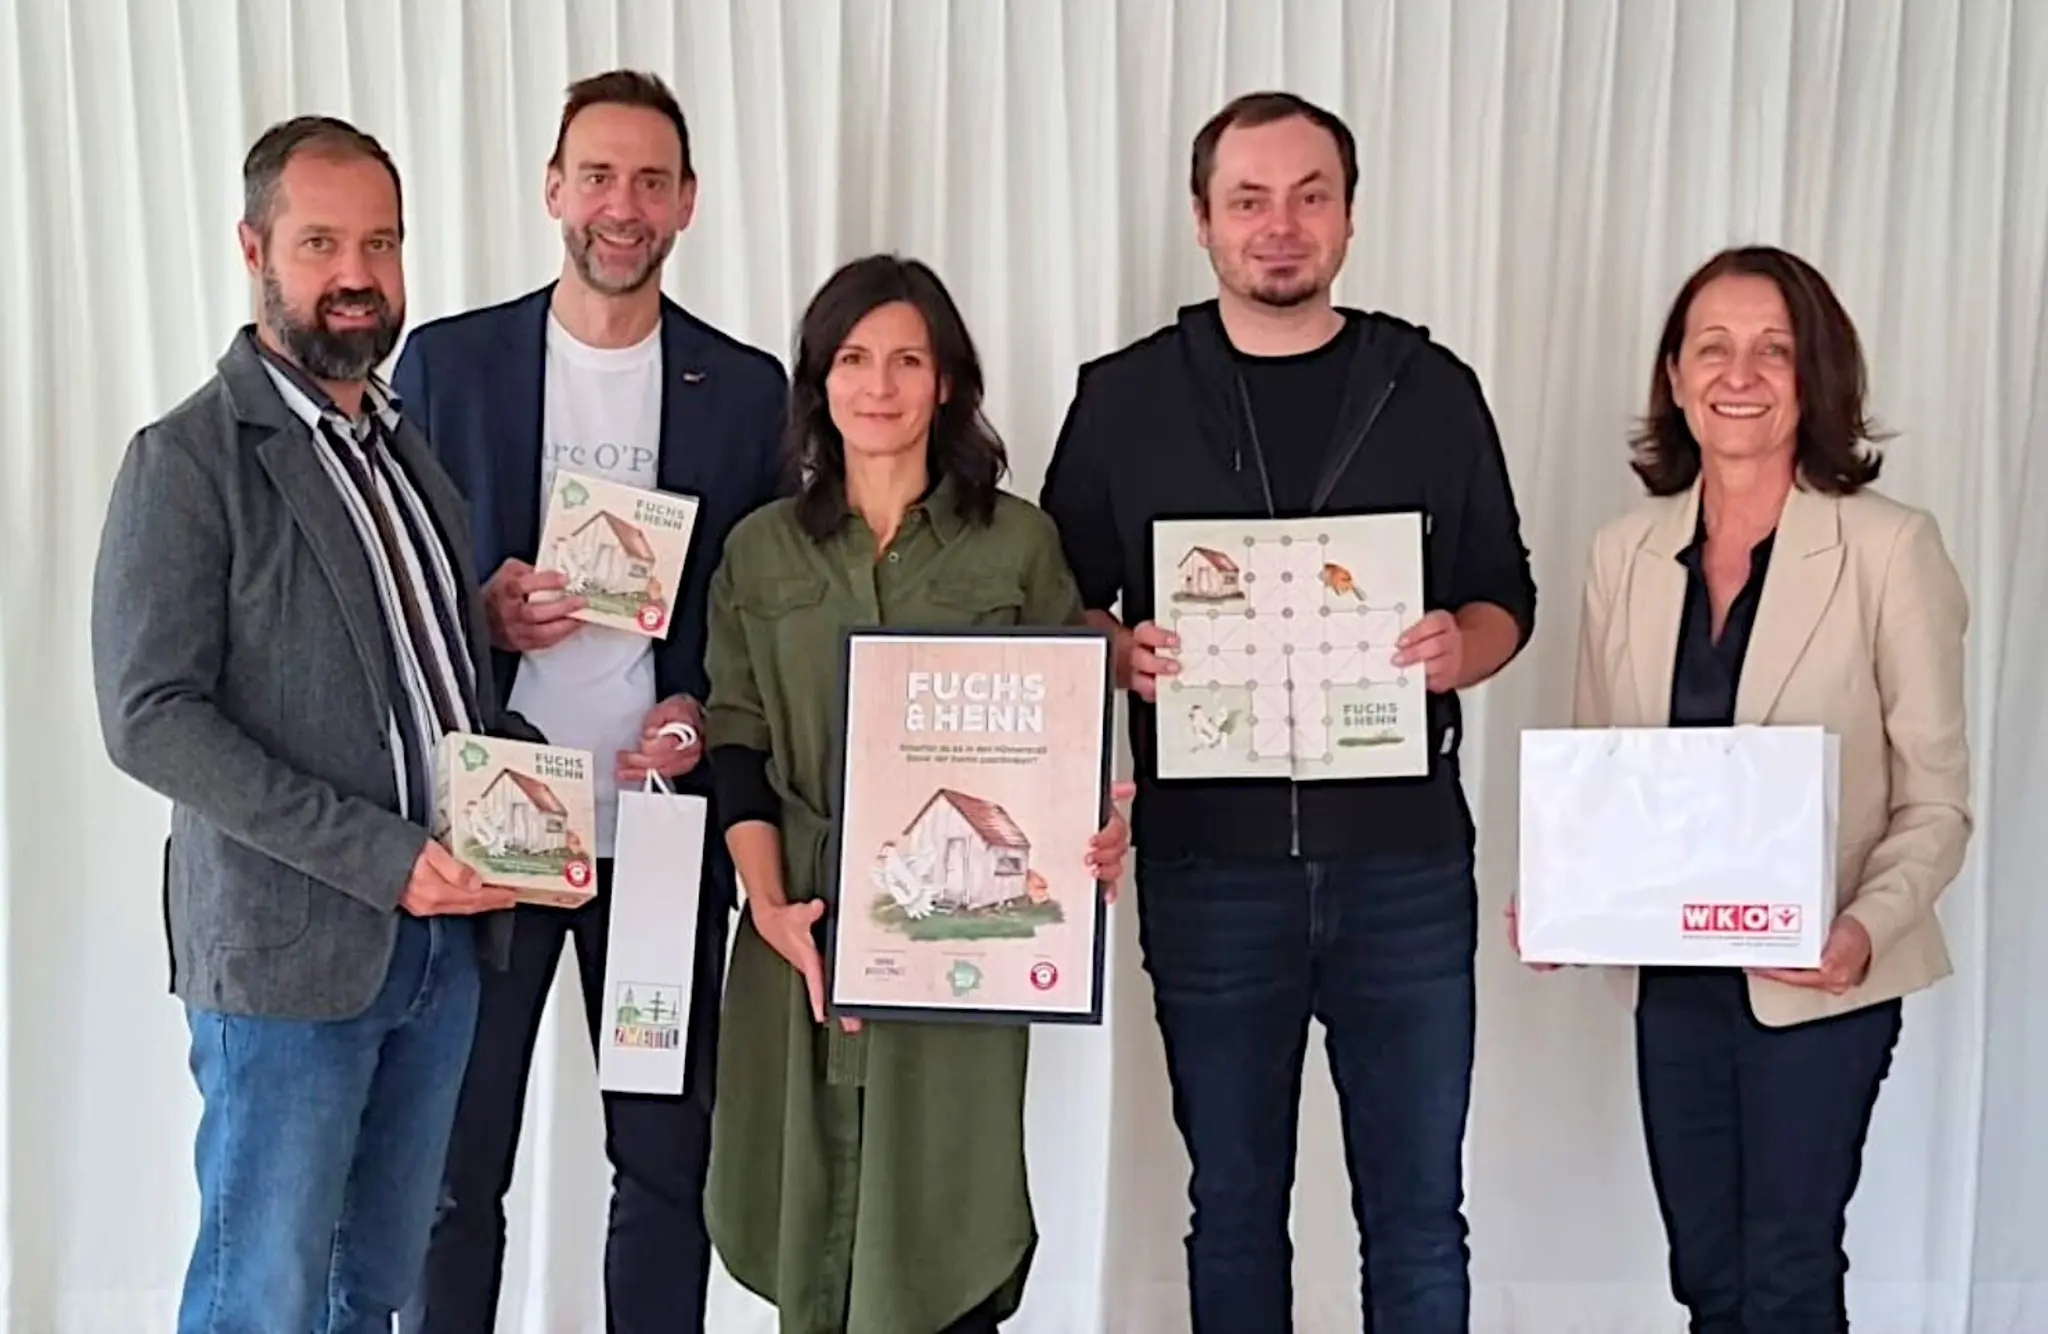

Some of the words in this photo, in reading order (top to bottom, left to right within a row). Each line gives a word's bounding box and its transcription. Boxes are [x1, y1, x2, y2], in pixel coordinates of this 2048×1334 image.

[636, 499, 684, 520] FUCHS
[906, 672, 1046, 702] FUCHS
[1343, 703, 1398, 714] FUCHS
[535, 752, 583, 769] FUCHS
[1684, 905, 1768, 930] WKO
